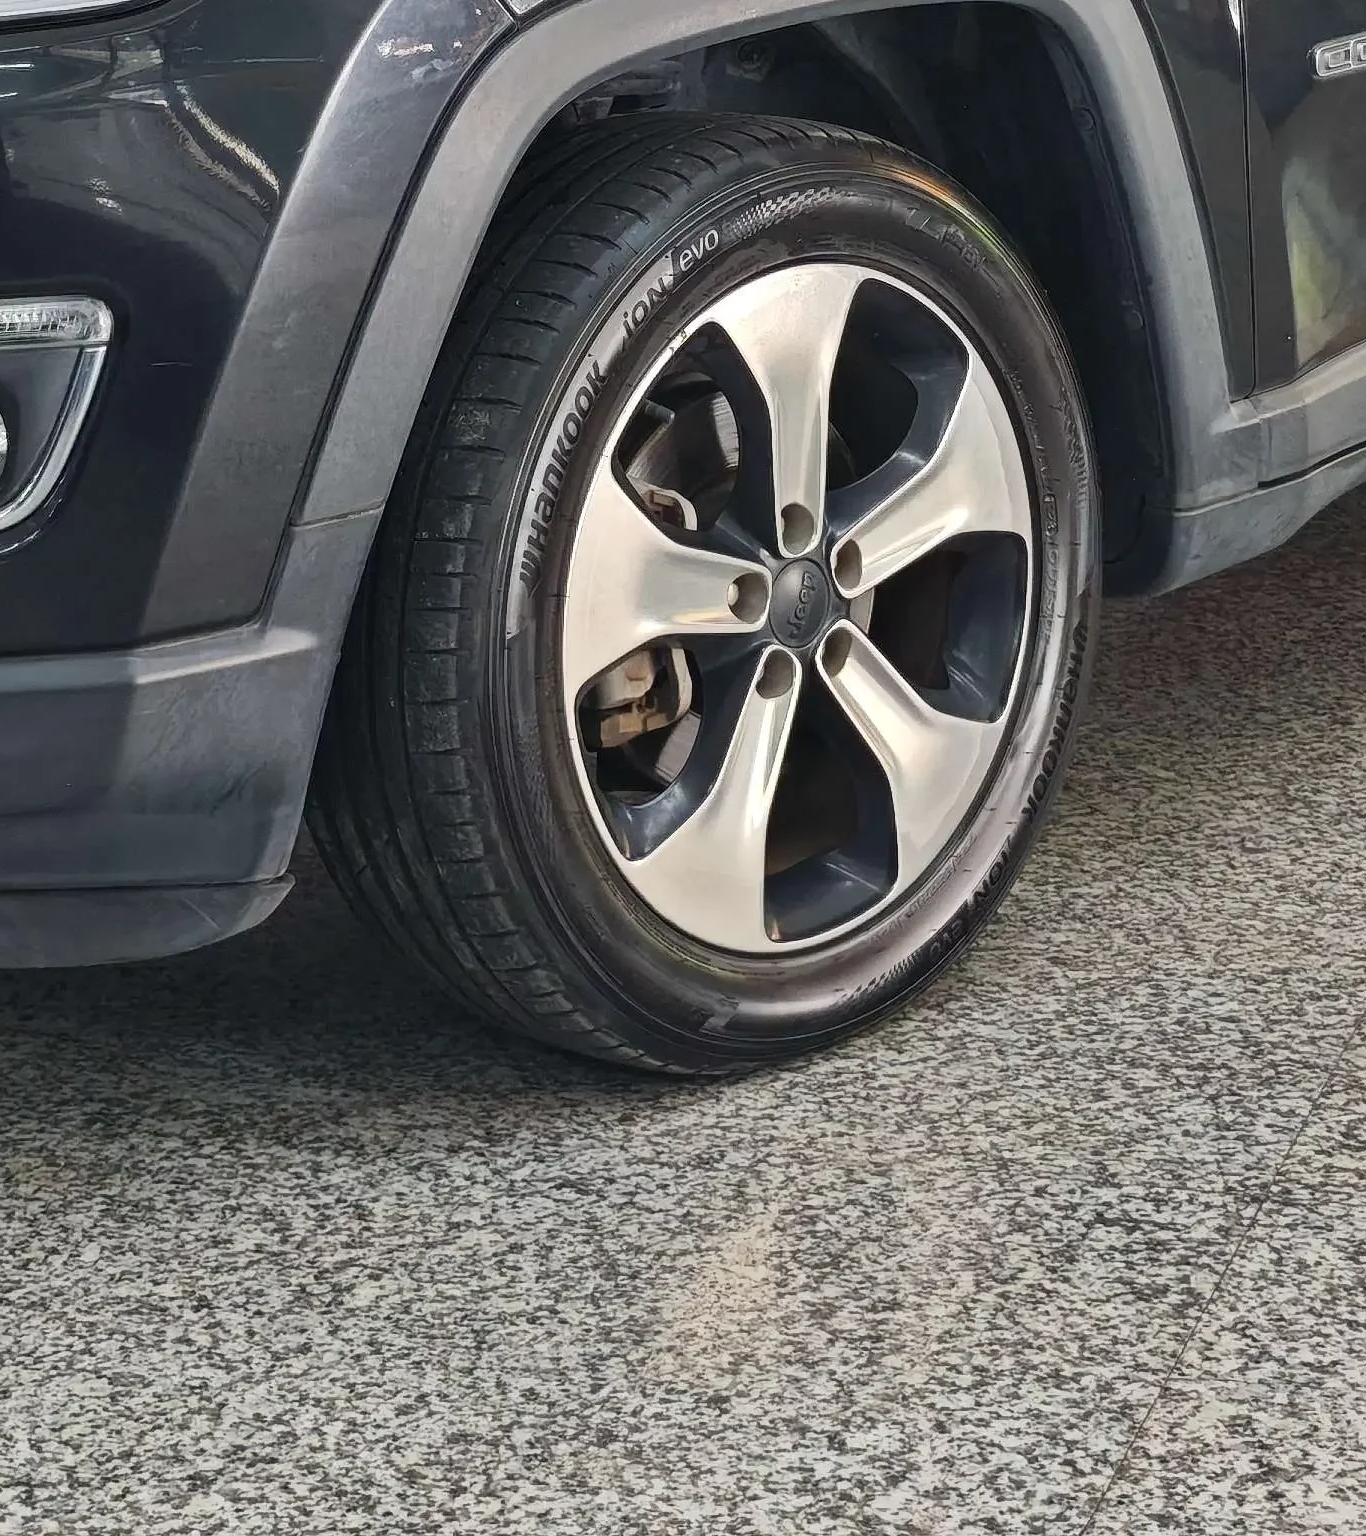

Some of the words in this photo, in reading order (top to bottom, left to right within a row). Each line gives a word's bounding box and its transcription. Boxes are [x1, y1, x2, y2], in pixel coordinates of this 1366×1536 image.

[523, 359, 609, 558] Hankook
[678, 228, 719, 271] evo
[786, 570, 817, 639] Jeep
